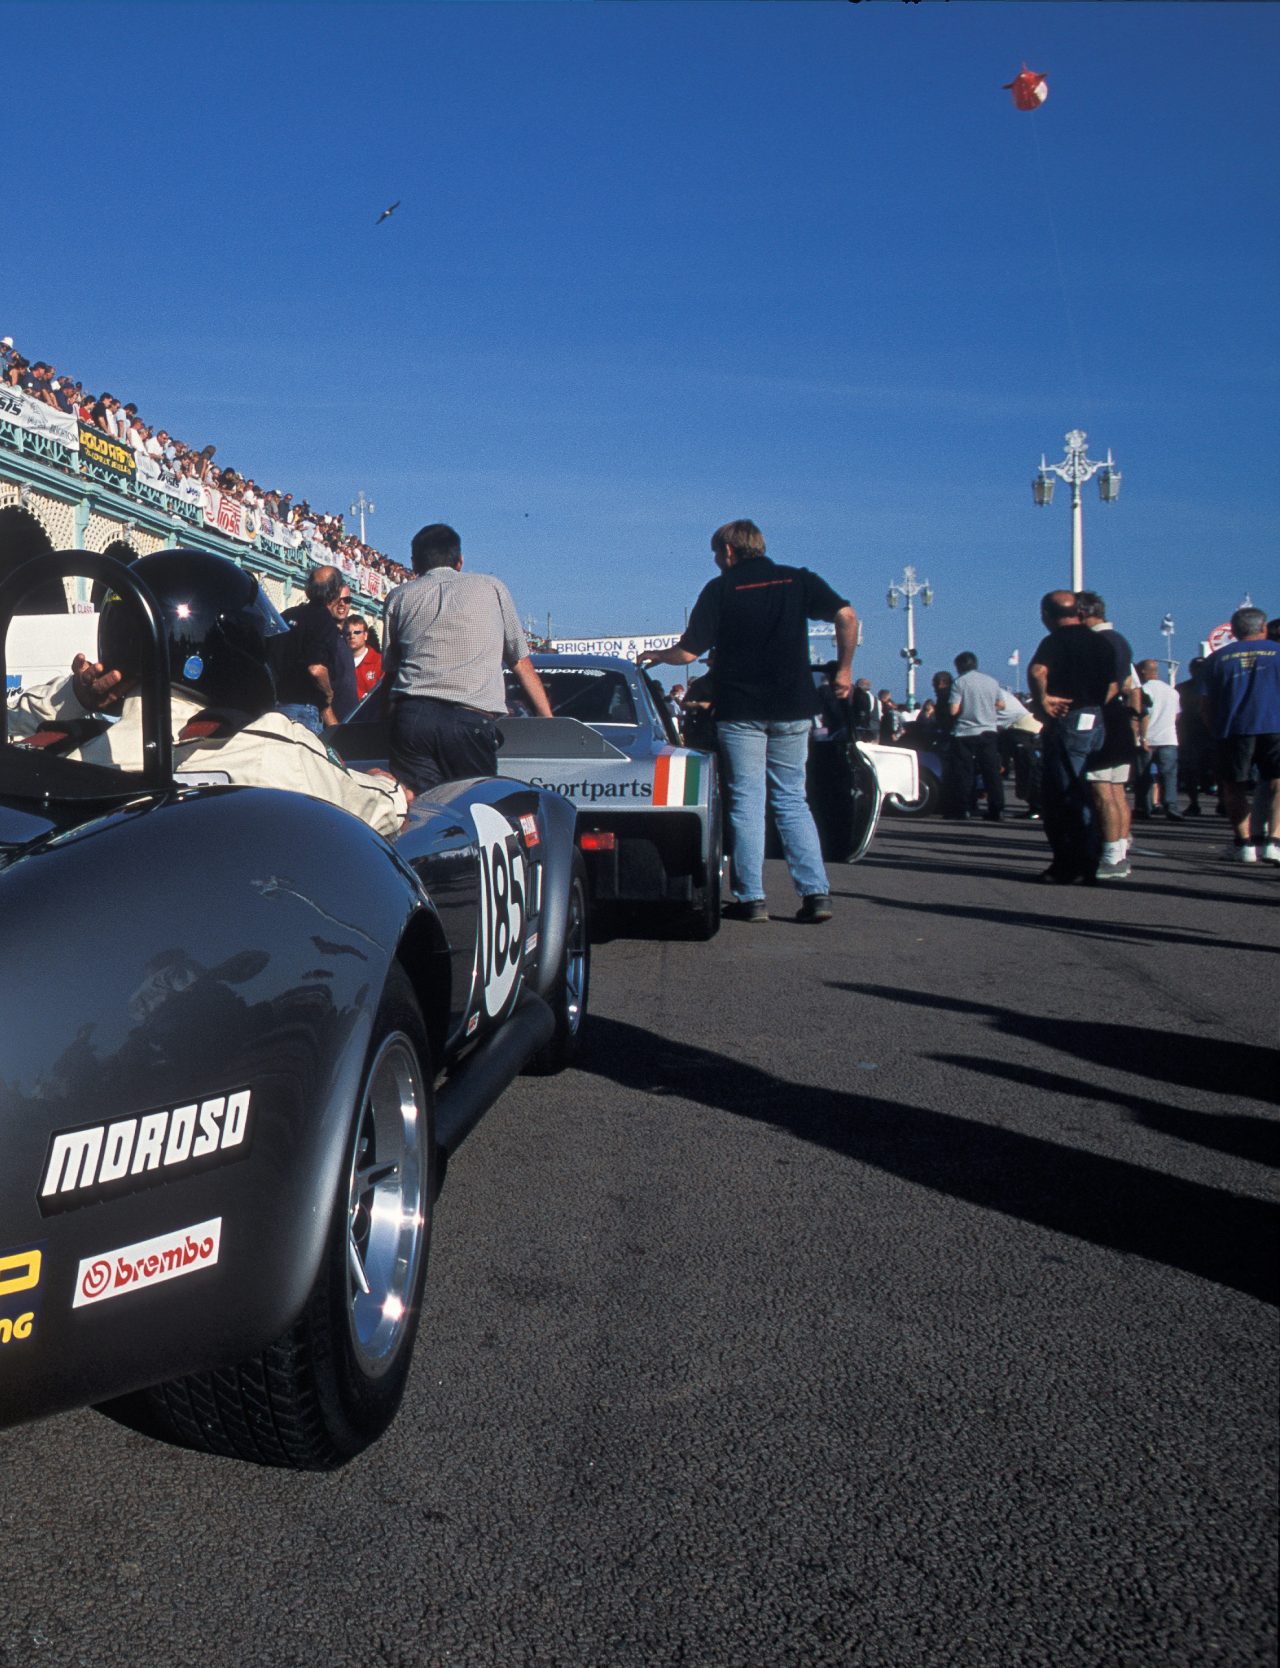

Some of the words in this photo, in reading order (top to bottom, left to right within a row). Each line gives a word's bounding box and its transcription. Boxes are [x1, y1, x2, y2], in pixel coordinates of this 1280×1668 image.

[556, 640, 623, 653] BRIGHTON
[627, 640, 637, 650] &
[643, 638, 680, 649] HOVE
[529, 777, 652, 801] Sportparts
[480, 833, 526, 988] 185
[41, 1090, 251, 1197] MOROSO
[113, 1235, 214, 1288] brembo
